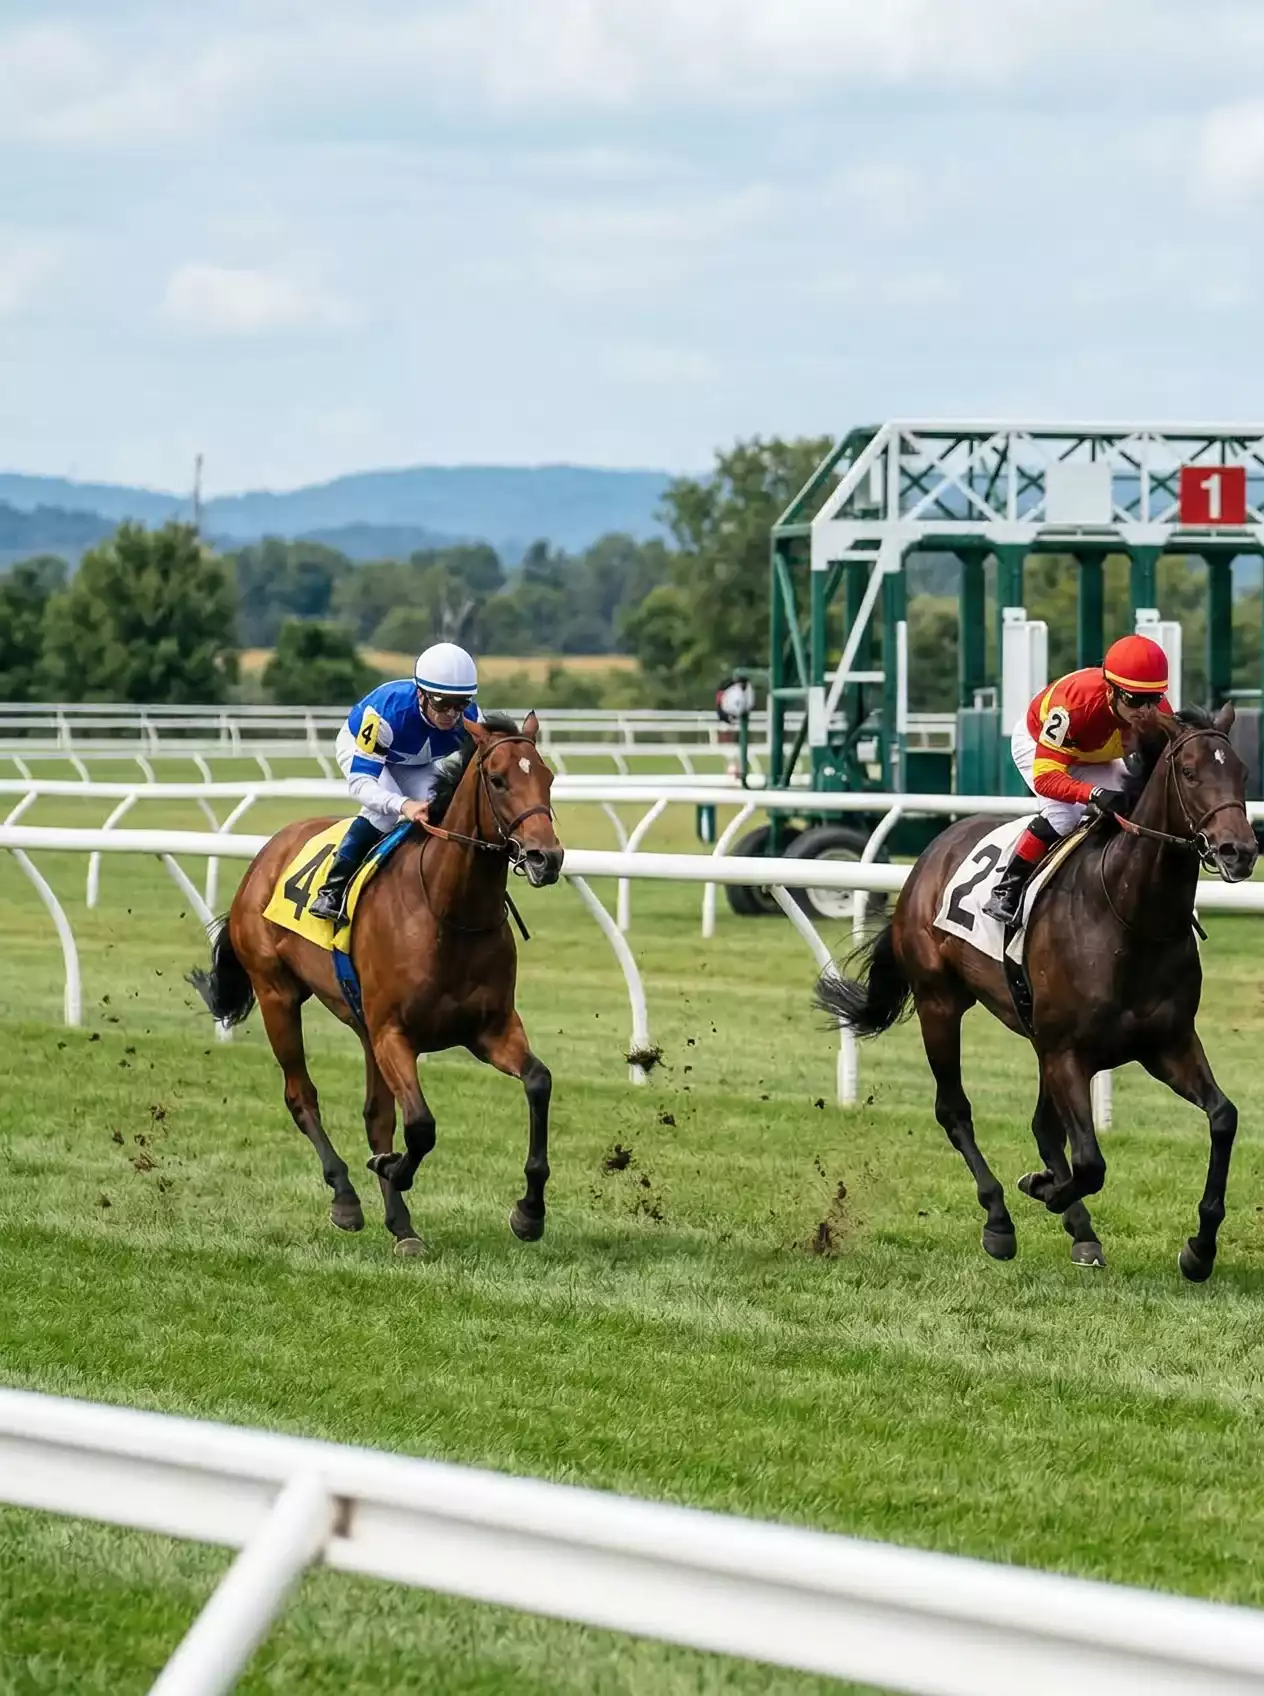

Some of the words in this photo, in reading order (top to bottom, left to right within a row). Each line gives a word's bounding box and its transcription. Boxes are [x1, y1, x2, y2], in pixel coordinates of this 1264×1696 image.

[1200, 475, 1222, 520] 1
[361, 723, 374, 746] 4
[1045, 713, 1063, 741] 2
[284, 843, 337, 921] 4
[946, 844, 1002, 932] 2
